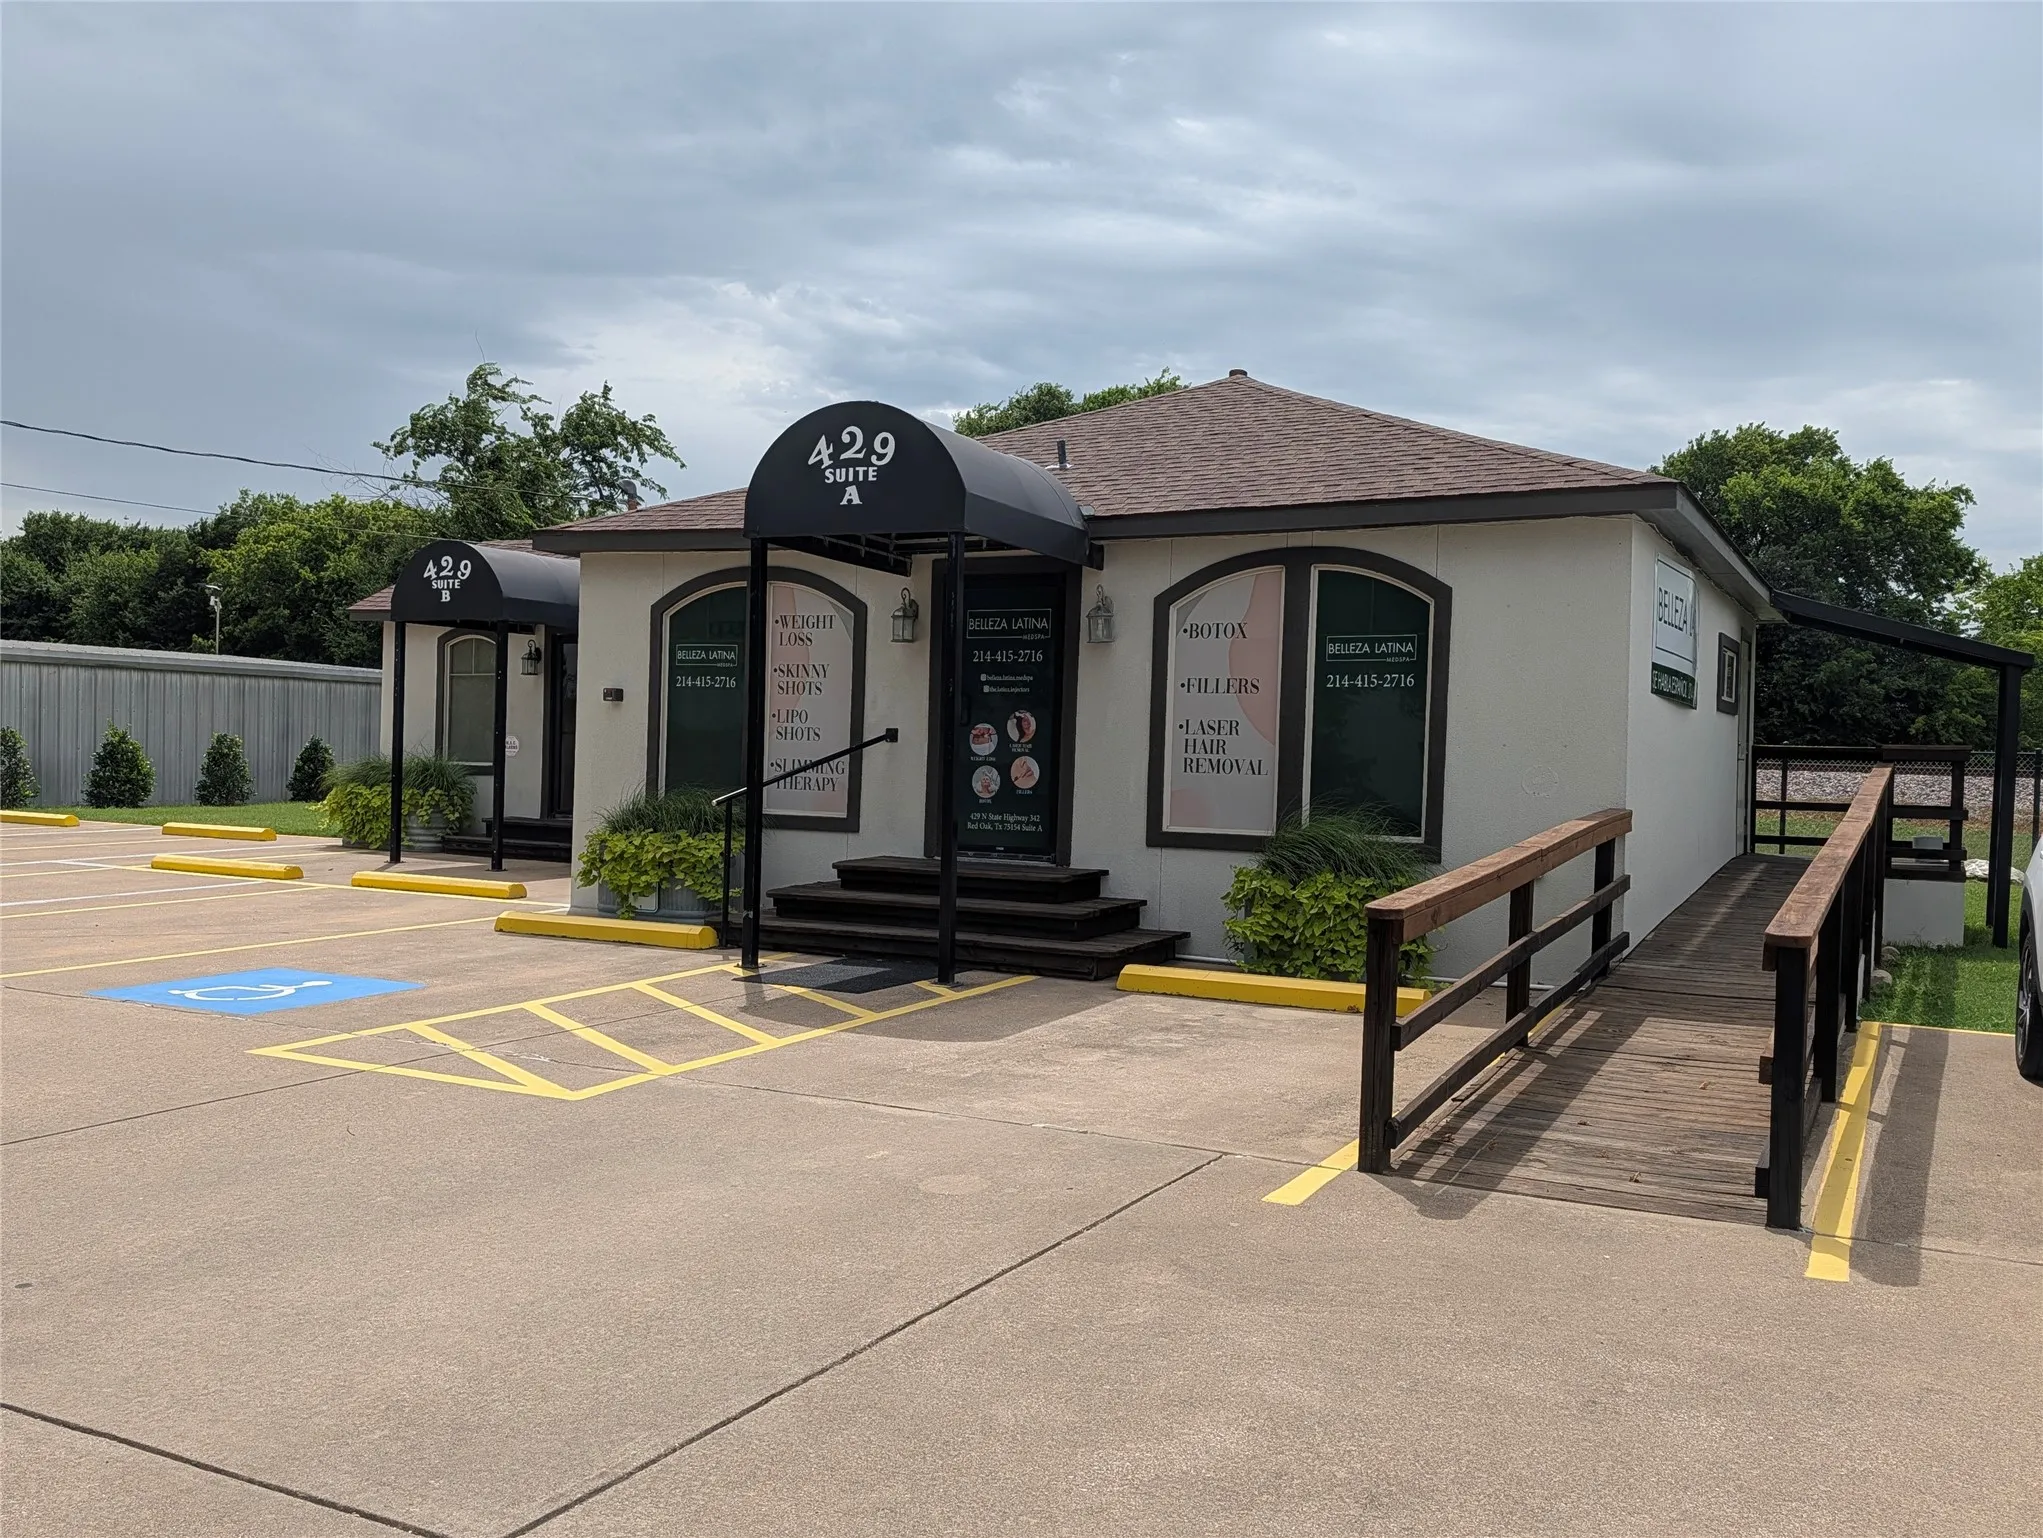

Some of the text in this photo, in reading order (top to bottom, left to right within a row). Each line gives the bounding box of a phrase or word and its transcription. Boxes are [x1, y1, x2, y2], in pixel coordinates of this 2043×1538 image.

[807, 425, 896, 469] 429
[824, 466, 878, 483] SUITE
[840, 484, 863, 505] A
[423, 555, 472, 580] 429
[431, 579, 461, 589] SUITE
[440, 590, 451, 602] B
[1658, 587, 1688, 635] BELLEZA
[779, 614, 836, 629] WEIGHT
[968, 617, 1048, 630] BELLEZA LATINA
[779, 632, 813, 646] LOSS
[1188, 622, 1248, 640] BOTOX
[677, 650, 736, 660] BELLEZA LATINA
[973, 650, 1043, 662] 214-415-2716
[1328, 642, 1414, 654] BELLEZA LATINA
[778, 663, 830, 679] SKINNY
[676, 675, 736, 688] 214-415-2716
[777, 680, 823, 696] SHOTS
[1186, 677, 1260, 695] FILLERS
[1326, 673, 1415, 688] 214-415-2716
[777, 709, 809, 724] LIPO
[775, 726, 821, 742] SHOTS
[1184, 719, 1240, 736] LASER
[1184, 738, 1227, 755] HAIR
[1182, 757, 1269, 776] REMOVAL
[775, 775, 839, 792] THERAPY
[970, 812, 981, 820] 429
[1003, 813, 1029, 823] Highway
[967, 821, 978, 829] Red
[995, 822, 1003, 830] Tx
[1021, 823, 1036, 832] Suite
